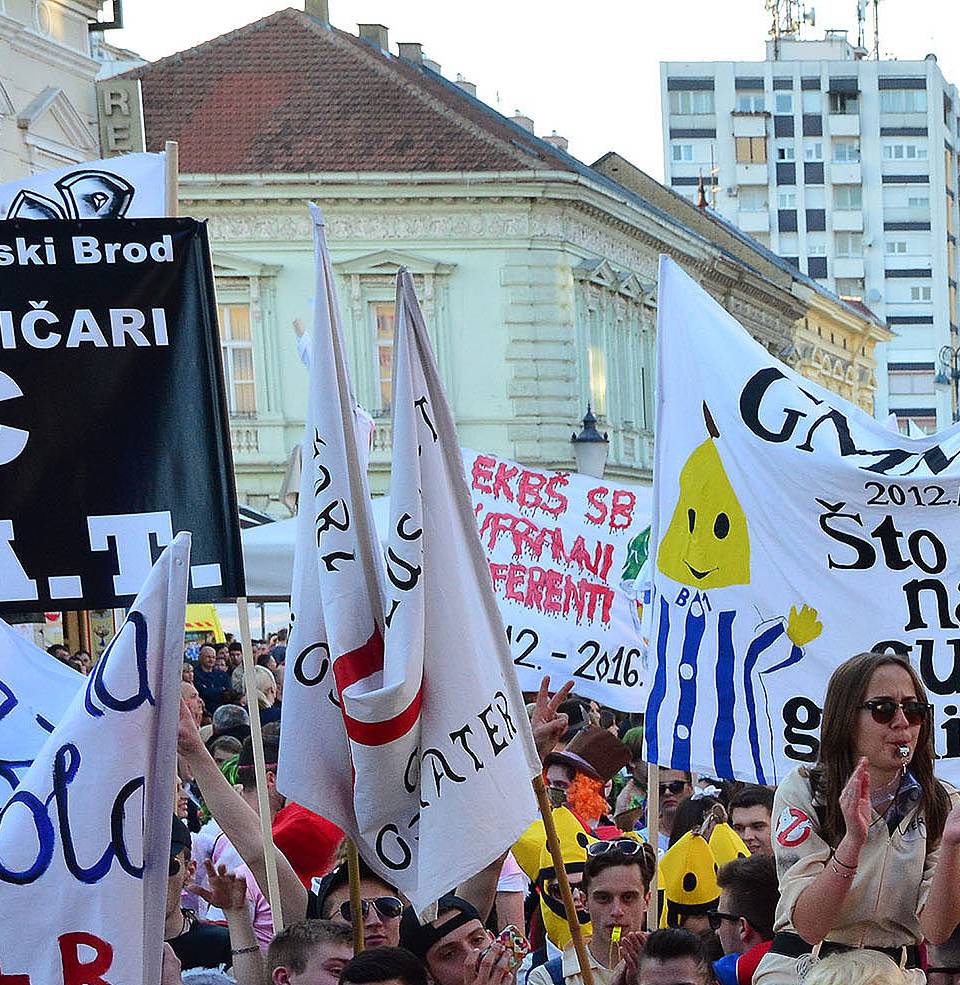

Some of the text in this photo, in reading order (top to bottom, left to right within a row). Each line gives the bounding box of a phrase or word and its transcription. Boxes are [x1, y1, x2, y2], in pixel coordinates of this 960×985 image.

[71, 234, 174, 265] Brod
[583, 487, 638, 534] SB
[815, 497, 947, 575] Što
[572, 639, 644, 689] 2016.
